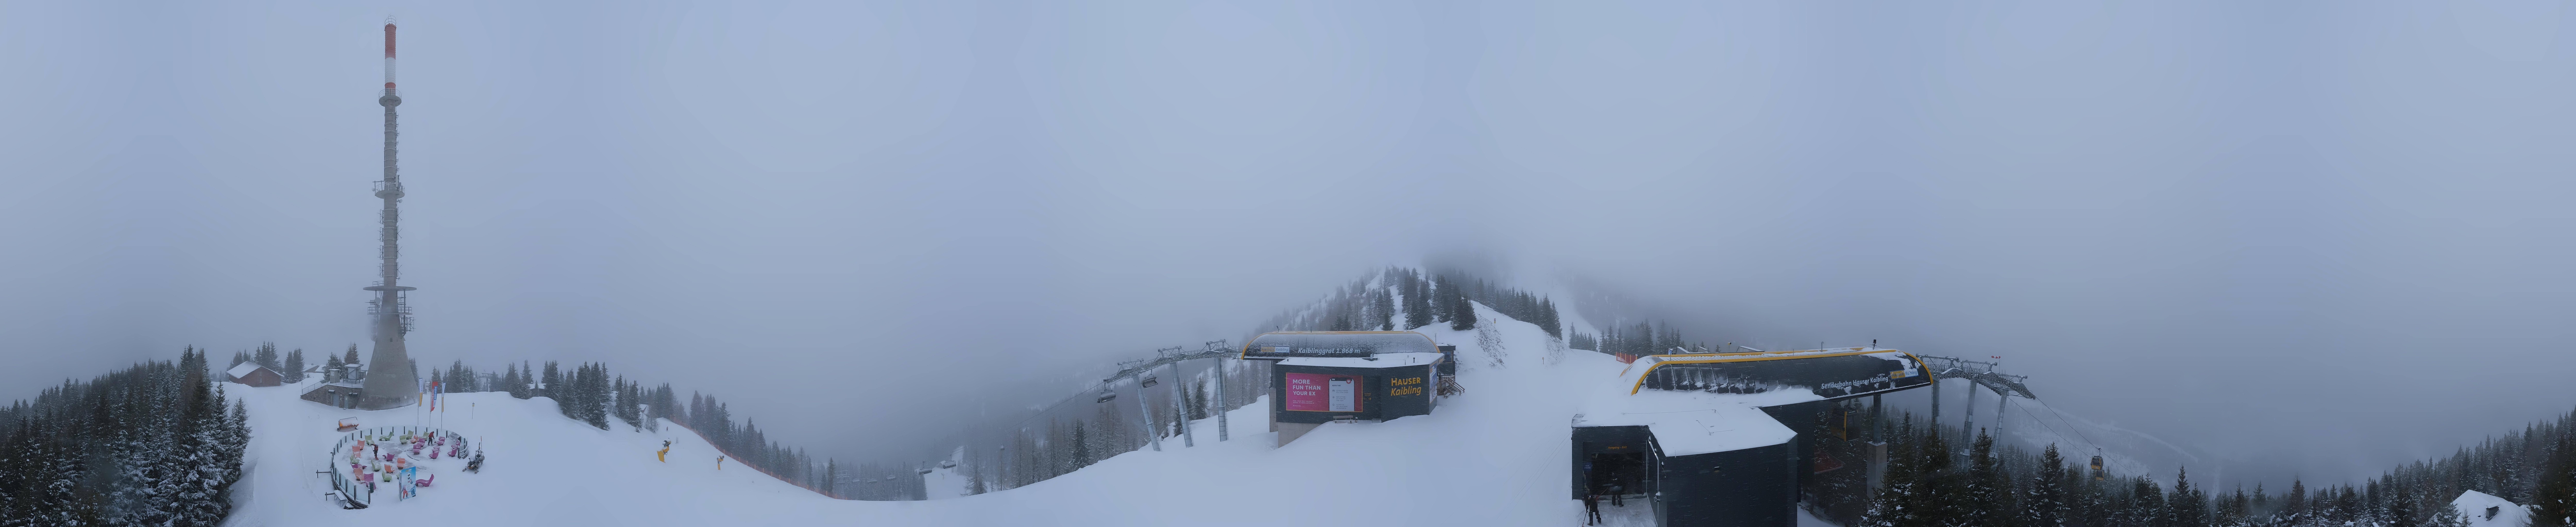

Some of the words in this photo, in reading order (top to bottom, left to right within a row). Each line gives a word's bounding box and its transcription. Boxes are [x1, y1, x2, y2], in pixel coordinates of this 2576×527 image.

[1391, 377, 1421, 386] HAUSER
[1821, 380, 1852, 389] Senderbahn
[1391, 386, 1421, 396] Kaibling
